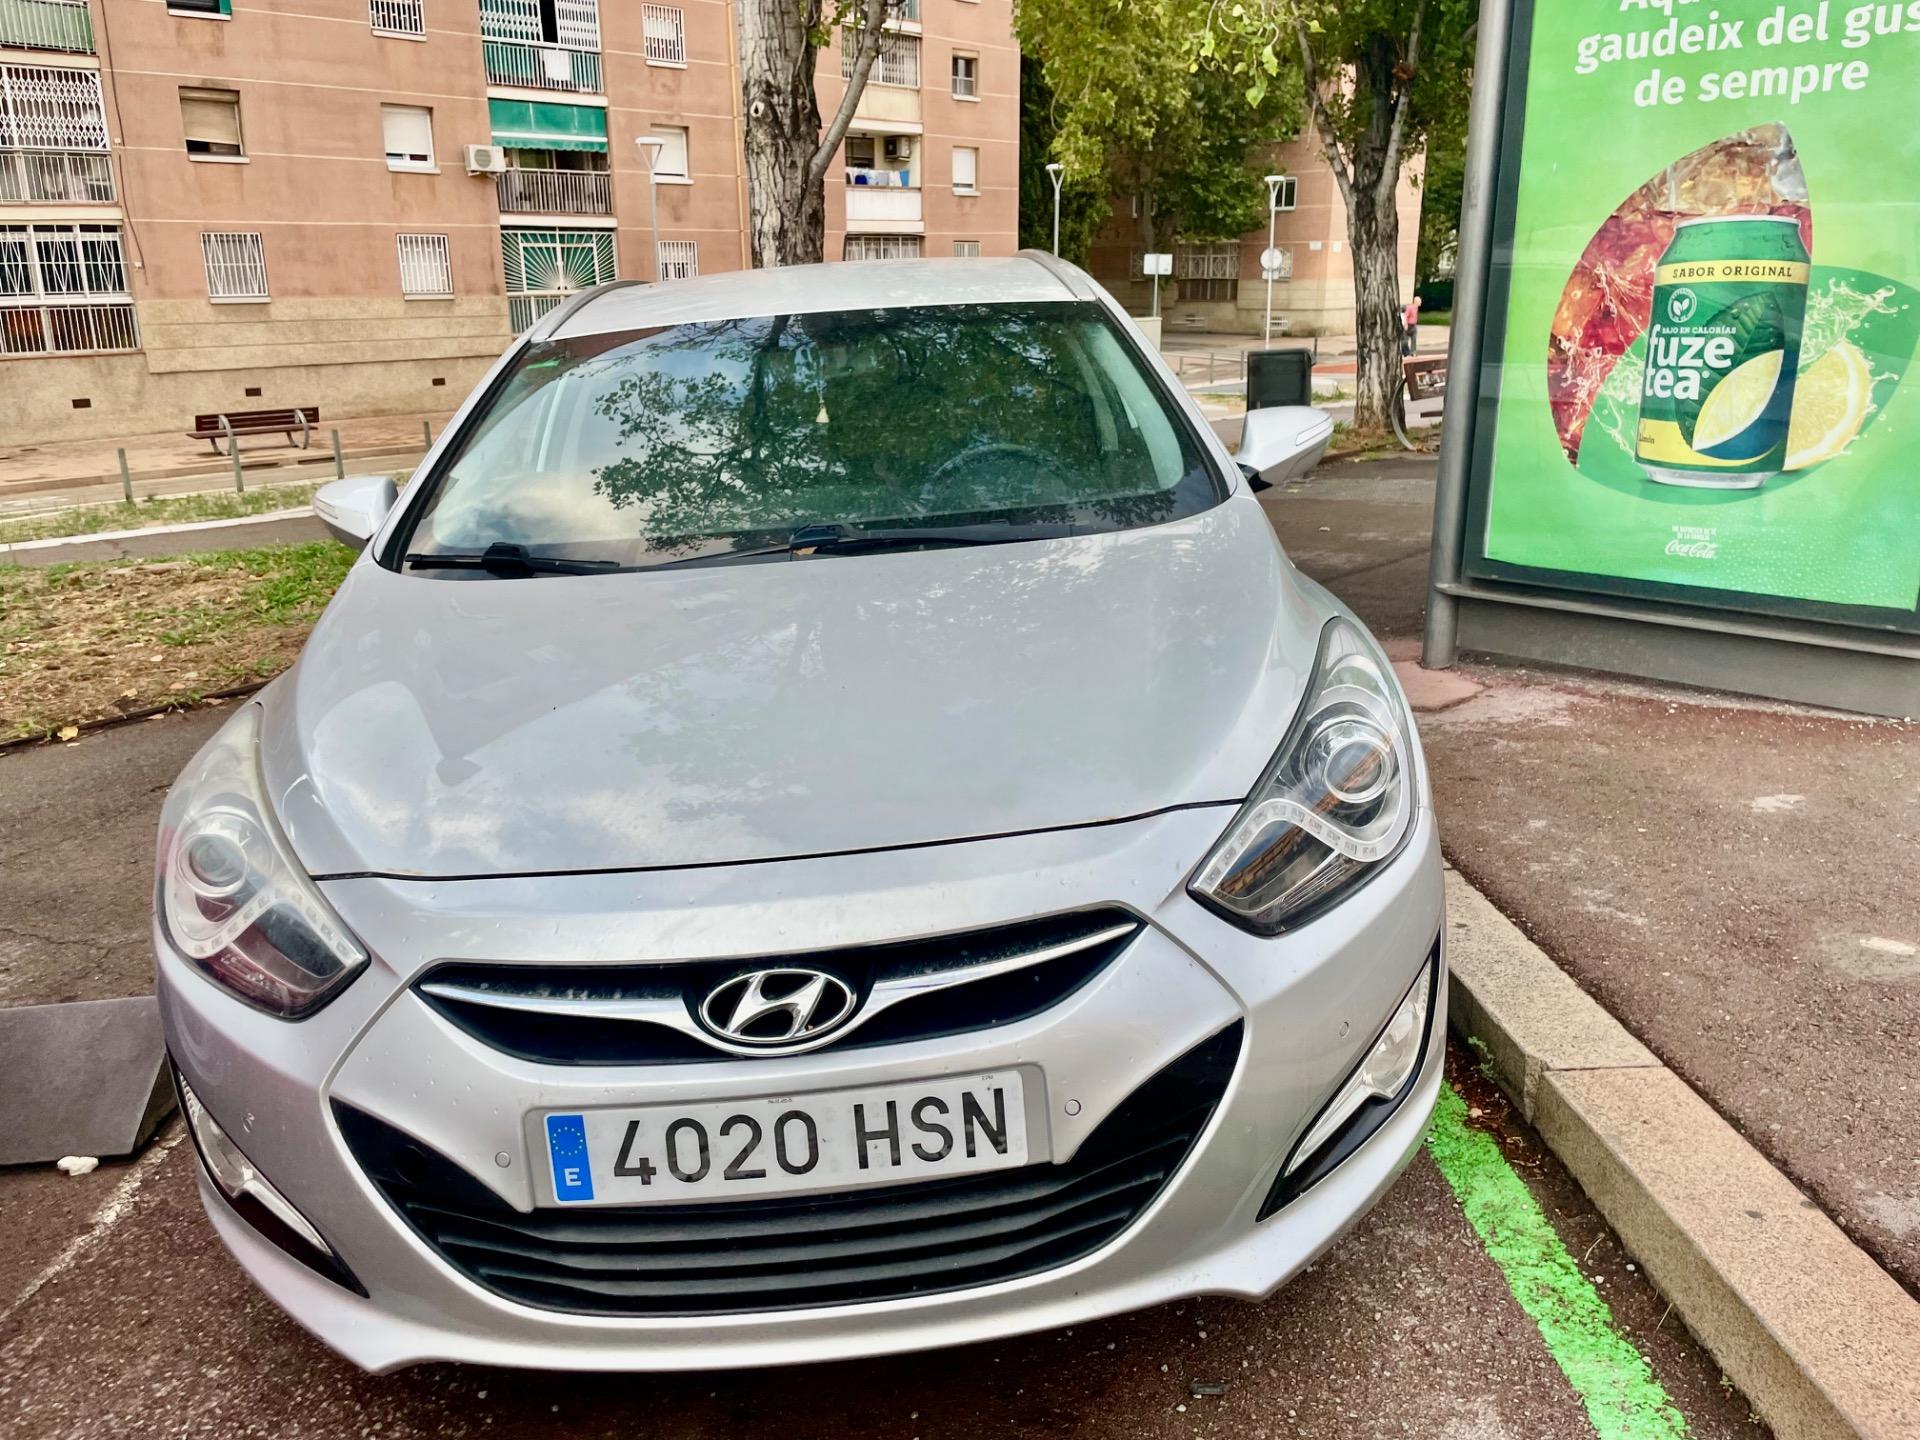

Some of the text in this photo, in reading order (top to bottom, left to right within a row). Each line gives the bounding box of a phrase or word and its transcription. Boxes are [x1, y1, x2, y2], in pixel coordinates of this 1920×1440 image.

[1575, 10, 1744, 74] gaudeix
[1757, 0, 1829, 46] del
[1634, 60, 1869, 107] de sempre
[1672, 265, 1793, 278] SABOR ORIGINAL
[1648, 324, 1735, 369] fuze
[1645, 367, 1701, 400] tea
[613, 1087, 1009, 1186] 4020 HSN
[565, 1167, 582, 1186] E
